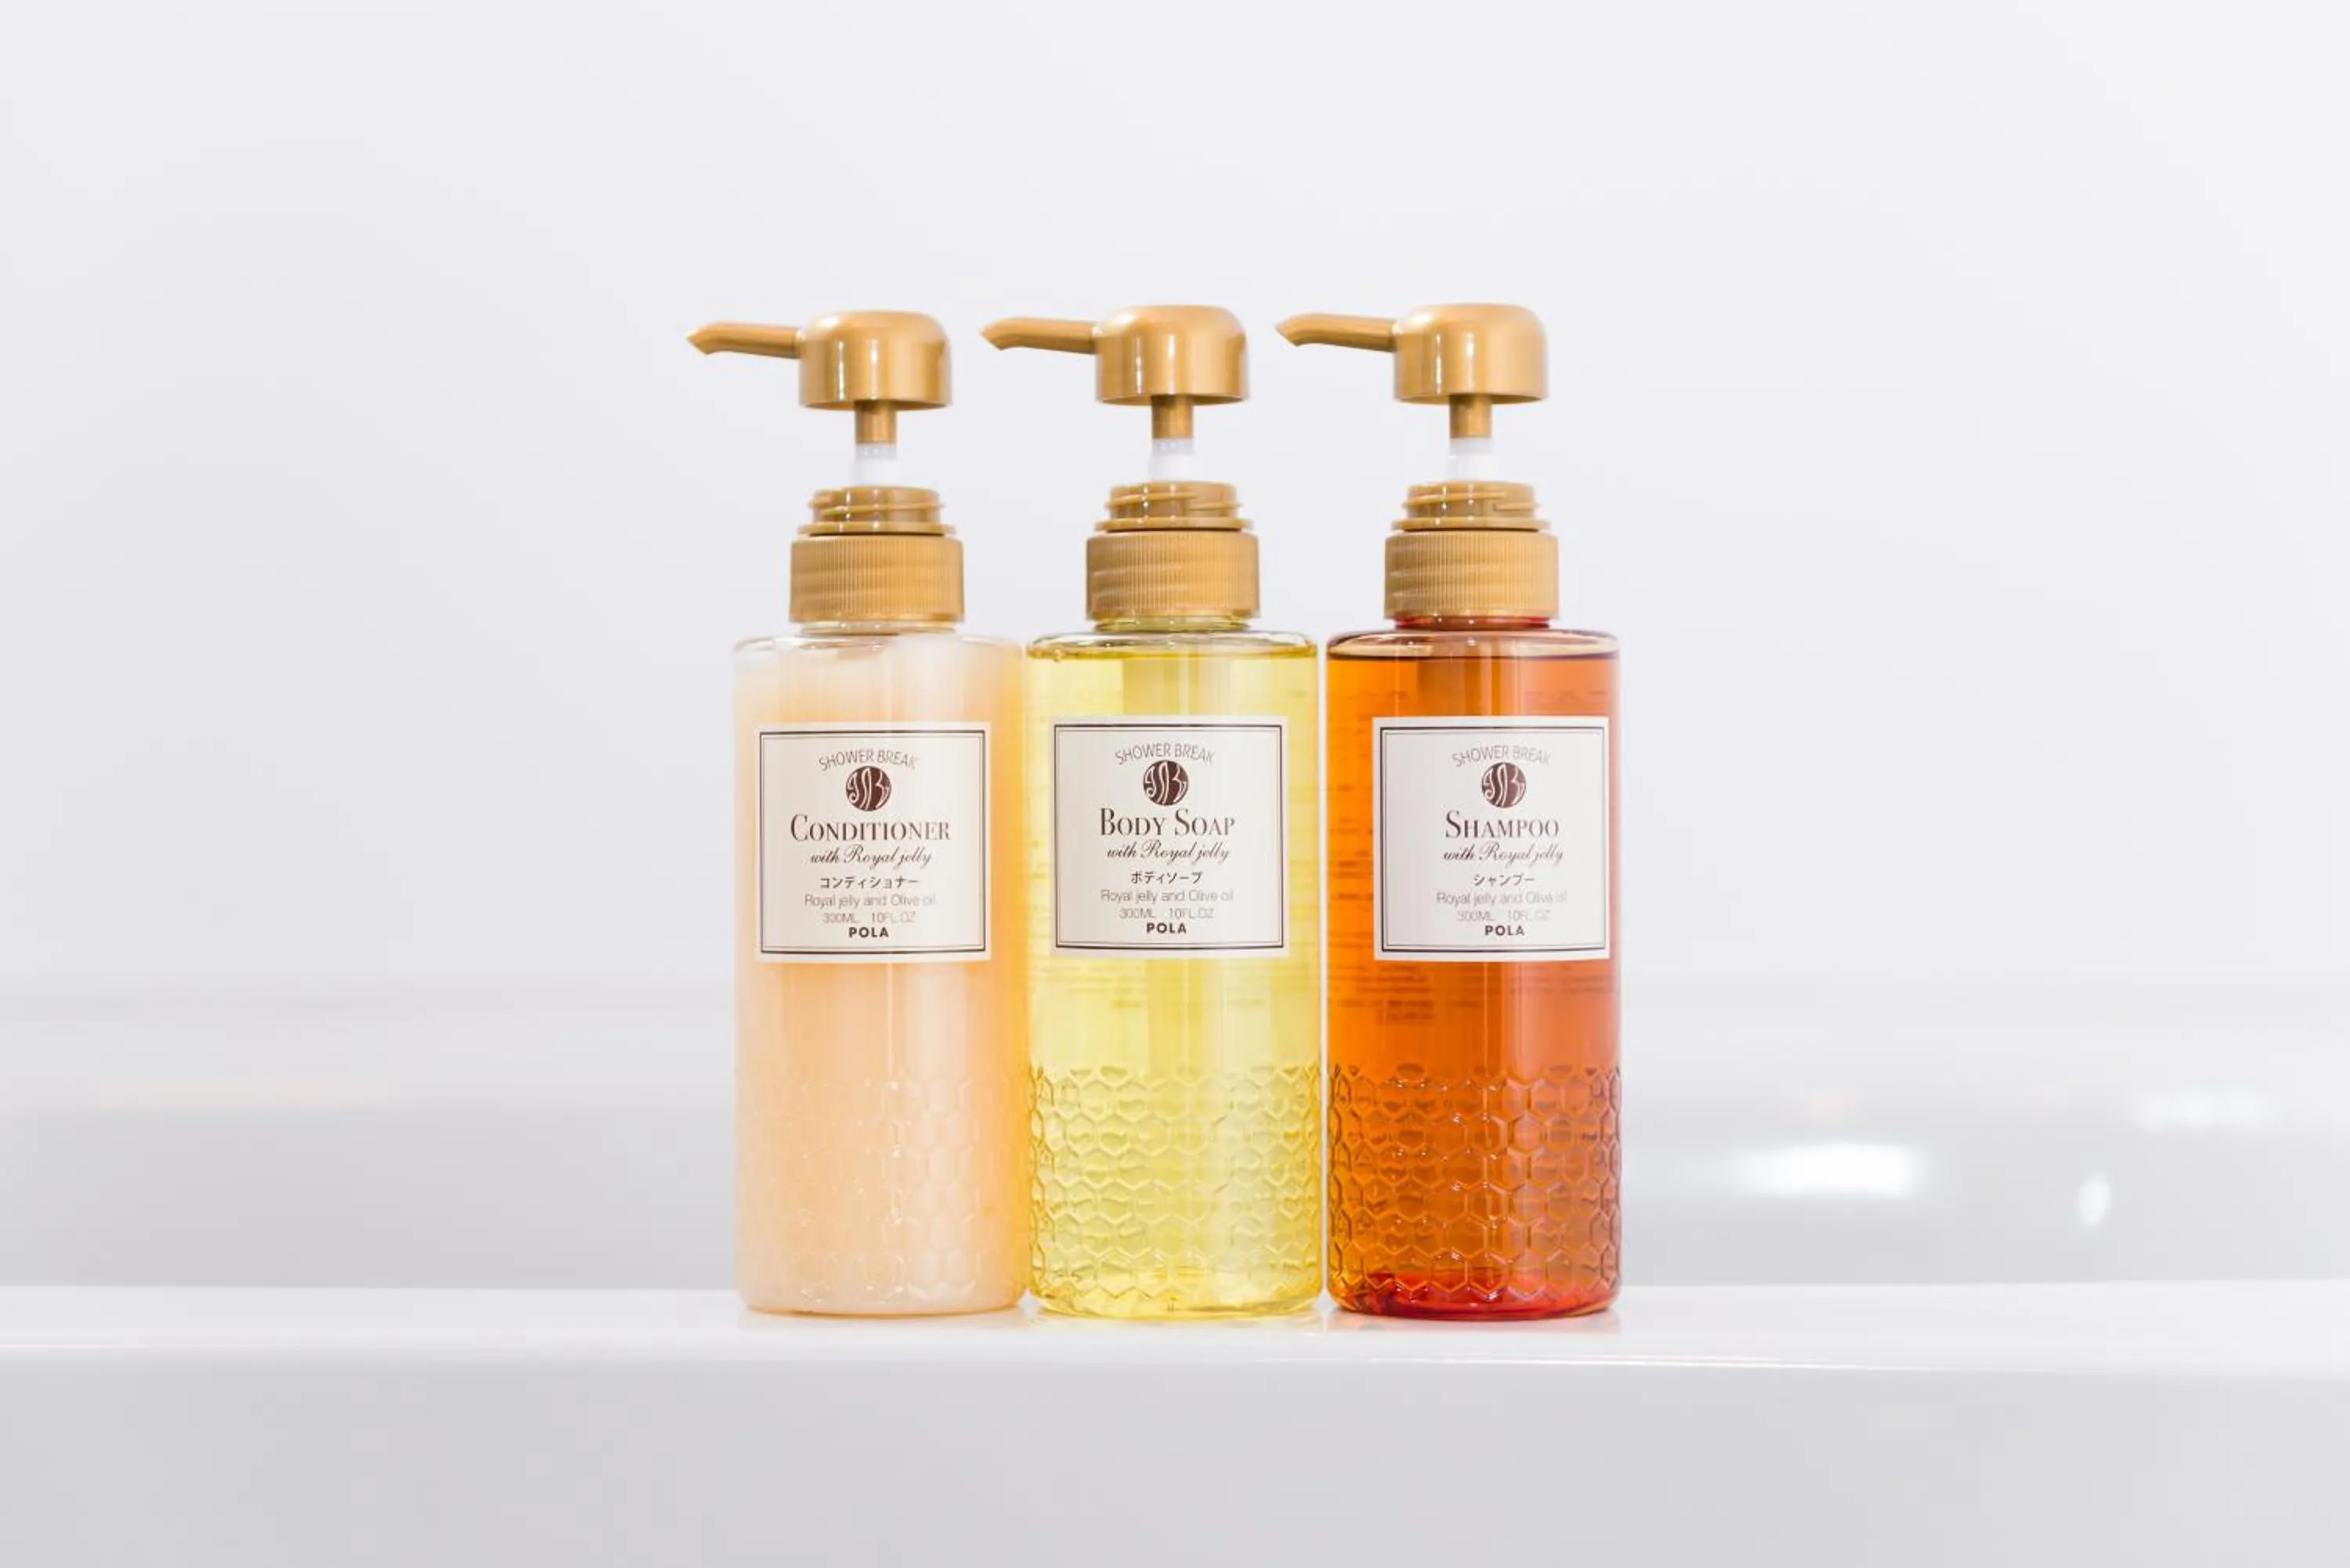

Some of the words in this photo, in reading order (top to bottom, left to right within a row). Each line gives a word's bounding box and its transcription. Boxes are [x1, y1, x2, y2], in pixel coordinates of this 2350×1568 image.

[819, 749, 873, 771] SHOWER
[877, 749, 918, 770] BREAK
[1115, 743, 1170, 765] SHOWER
[1174, 743, 1215, 763] BREAK
[1452, 745, 1509, 768] SHOWER
[1513, 746, 1551, 765] BREAK
[790, 813, 951, 842] CONDITIONER
[1100, 807, 1166, 836] BODY
[1174, 807, 1235, 836] SOAP
[1444, 809, 1559, 839] SHAMPOO
[810, 847, 840, 864] with
[844, 844, 898, 870] Royal
[895, 847, 931, 870] jelly
[1107, 842, 1137, 858] with
[1141, 839, 1195, 865] Royal
[1195, 841, 1230, 865] jelly
[1443, 844, 1475, 861] with
[1479, 841, 1531, 867] Royal
[1531, 844, 1564, 867] jelly
[820, 876, 919, 889] コンディショナー
[1131, 871, 1203, 884] ボディソープ
[1473, 873, 1535, 887] シャンプー
[804, 894, 836, 908] Royal
[838, 894, 860, 909] jelly
[864, 894, 888, 905] and
[891, 894, 920, 905] Olive
[922, 894, 936, 905] oil
[1101, 889, 1133, 903] Royal
[1136, 890, 1159, 904] jelly
[1162, 890, 1185, 901] and
[1188, 889, 1217, 901] Olive
[1220, 889, 1234, 901] oil
[1437, 891, 1471, 906] Royal
[1473, 892, 1496, 907] jelly
[1499, 892, 1522, 904] and
[1526, 891, 1553, 904] Olive
[822, 912, 858, 923] 300ML
[1119, 908, 1155, 919] 300ML
[1457, 910, 1495, 921] 300ML
[848, 927, 889, 938] POLA
[1146, 922, 1187, 934] POLA
[1484, 925, 1525, 936] POLA
